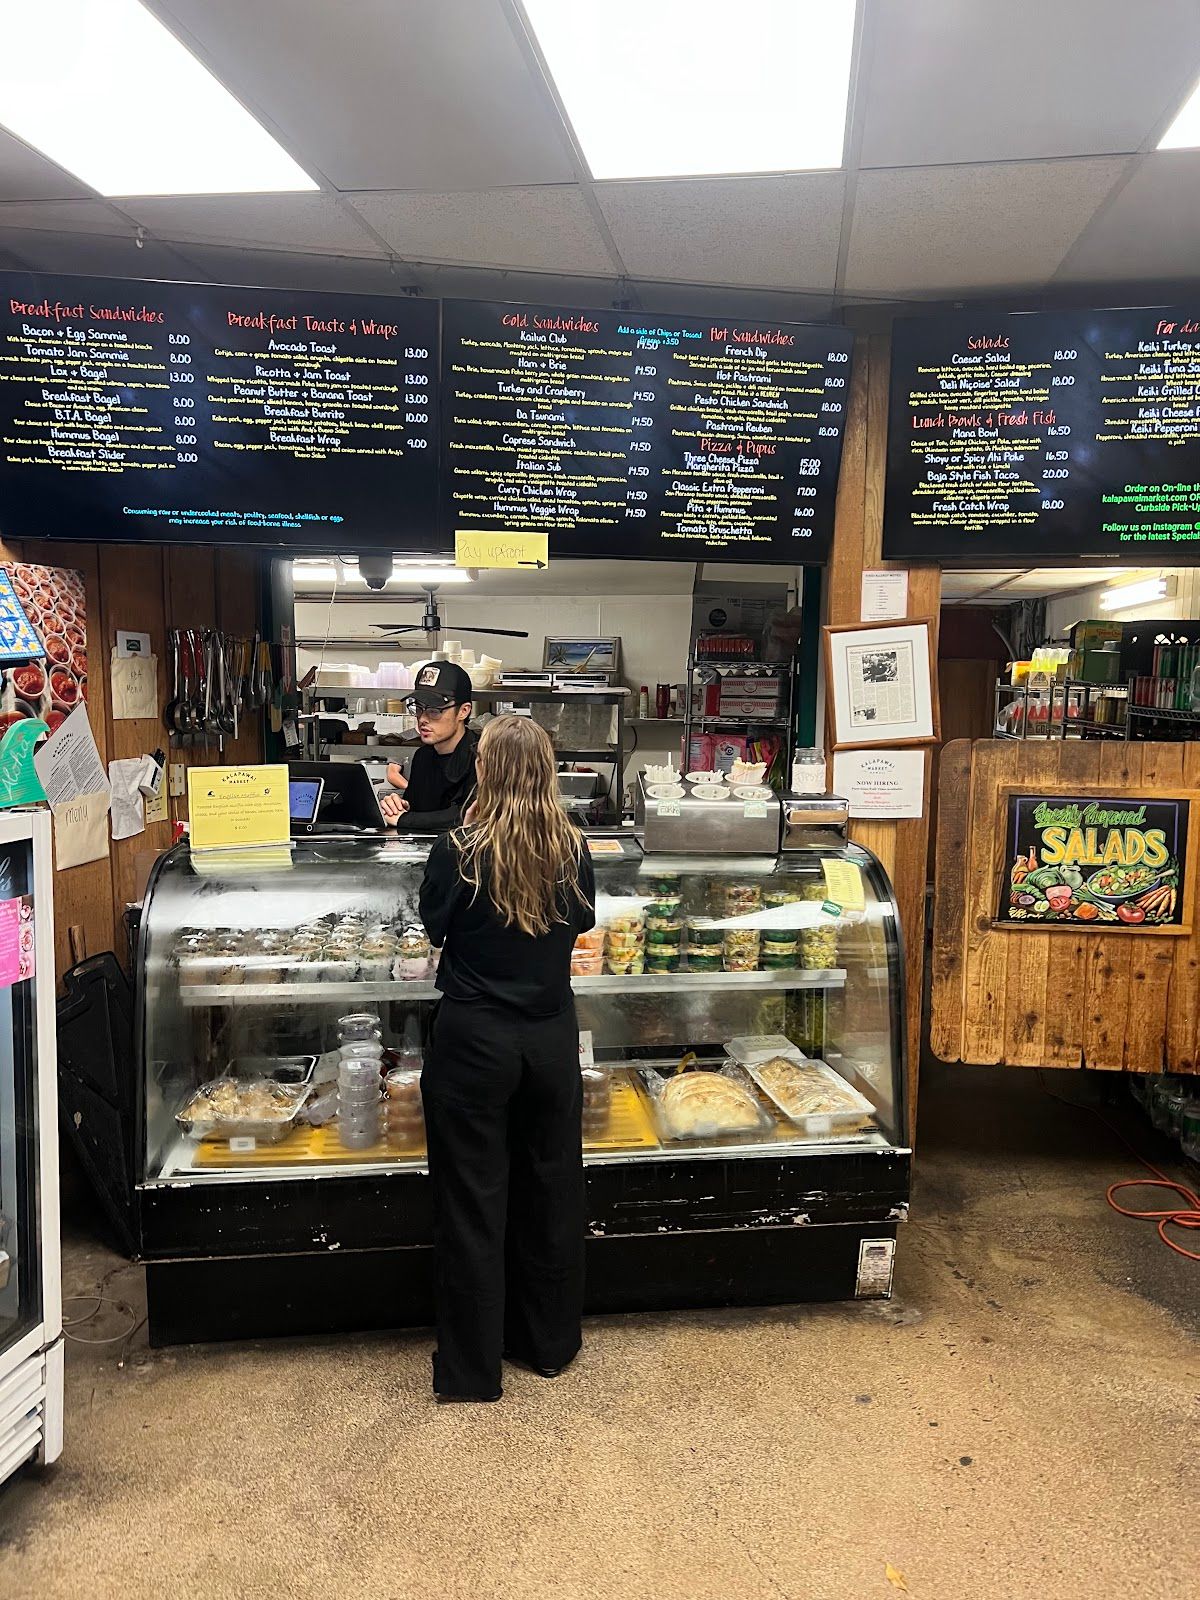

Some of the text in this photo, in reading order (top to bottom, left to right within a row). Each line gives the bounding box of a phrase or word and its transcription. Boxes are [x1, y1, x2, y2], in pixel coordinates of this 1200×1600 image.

[10, 300, 164, 323] Breakfast Sandwiches
[227, 312, 298, 334] Breakfast
[302, 316, 345, 332] Toasts
[361, 320, 398, 340] Wraps
[534, 315, 599, 332] Sandwiches
[1157, 320, 1177, 335] For
[22, 324, 127, 342] Bacon Egg Sammie
[520, 330, 567, 344] Kailua Club
[657, 329, 672, 337] Chips
[710, 328, 795, 346] Hot Sandwiches
[169, 334, 190, 345] 8.00
[968, 336, 1009, 349] Salads
[268, 339, 337, 354] Avocado Toast
[726, 344, 768, 359] French Dip
[1138, 340, 1192, 352] Keiki Turkey
[404, 347, 428, 358] 13.00
[827, 352, 848, 363] 18.00
[1054, 350, 1077, 360] 18.00
[170, 354, 191, 364] 8.00
[518, 357, 567, 370] Ham Brie
[952, 353, 1011, 364] Caesar Salad
[50, 365, 68, 376] Lox
[80, 367, 108, 381] Bagel
[635, 366, 656, 376] 14.50
[170, 372, 194, 383] 13.00
[404, 374, 428, 385] 13.00
[716, 370, 771, 384] Hot Pastrami
[1052, 376, 1074, 386] 18.00
[825, 378, 844, 388] 18.00
[994, 378, 1020, 388] Salad
[233, 385, 373, 401] Peanut Butter Banana Toast
[497, 382, 585, 399] Turkey and Cranberry
[1138, 385, 1193, 396] Keiki Grilled
[633, 391, 655, 402] 14.50
[695, 394, 788, 410] Pesto Chicken Sandwich
[173, 398, 194, 408] 8.00
[821, 402, 842, 412] 18.00
[54, 409, 112, 424] B.T.A. Bagel
[405, 413, 428, 423] 10.00
[516, 408, 564, 421] Da Tsunami
[912, 413, 944, 428] Lunch
[949, 414, 982, 428] Bowls
[998, 410, 1028, 426] Fresh
[1033, 409, 1056, 425] Fish
[174, 416, 195, 426] 8.00
[632, 417, 653, 427] 14.50
[953, 428, 998, 438] Mana Bowl
[1048, 426, 1070, 436] 16.50
[407, 438, 427, 449] 9.00
[701, 438, 732, 452] Pizza
[746, 440, 777, 458] Pupus
[48, 446, 126, 459] Breakfast Slider
[684, 451, 759, 465] Three Cheese Pizza
[925, 451, 1024, 464] Shoyu or Spicy Ahi Poke
[516, 460, 561, 472] Italian Sub
[800, 458, 820, 468] 15.00
[799, 467, 819, 476] 16.00
[927, 469, 1019, 482] Baja Style Fish Tacos
[1042, 469, 1069, 479] 20.00
[672, 480, 764, 496] Classic Extra Pepperoni
[797, 487, 816, 496] 17.00
[123, 506, 157, 517] Consuming
[494, 502, 579, 517] Hummus Veggie Wrap
[1135, 503, 1170, 511] Curbside
[1103, 523, 1128, 531] Follow
[1153, 522, 1192, 532] Instagram
[1120, 532, 1170, 540] for the latest
[457, 539, 526, 562] Pay upfront
[861, 759, 895, 768] KALAPAWAI
[222, 772, 257, 782] KALAPAWAI
[1083, 802, 1146, 828] Prepared
[1041, 827, 1170, 868] SALADS
